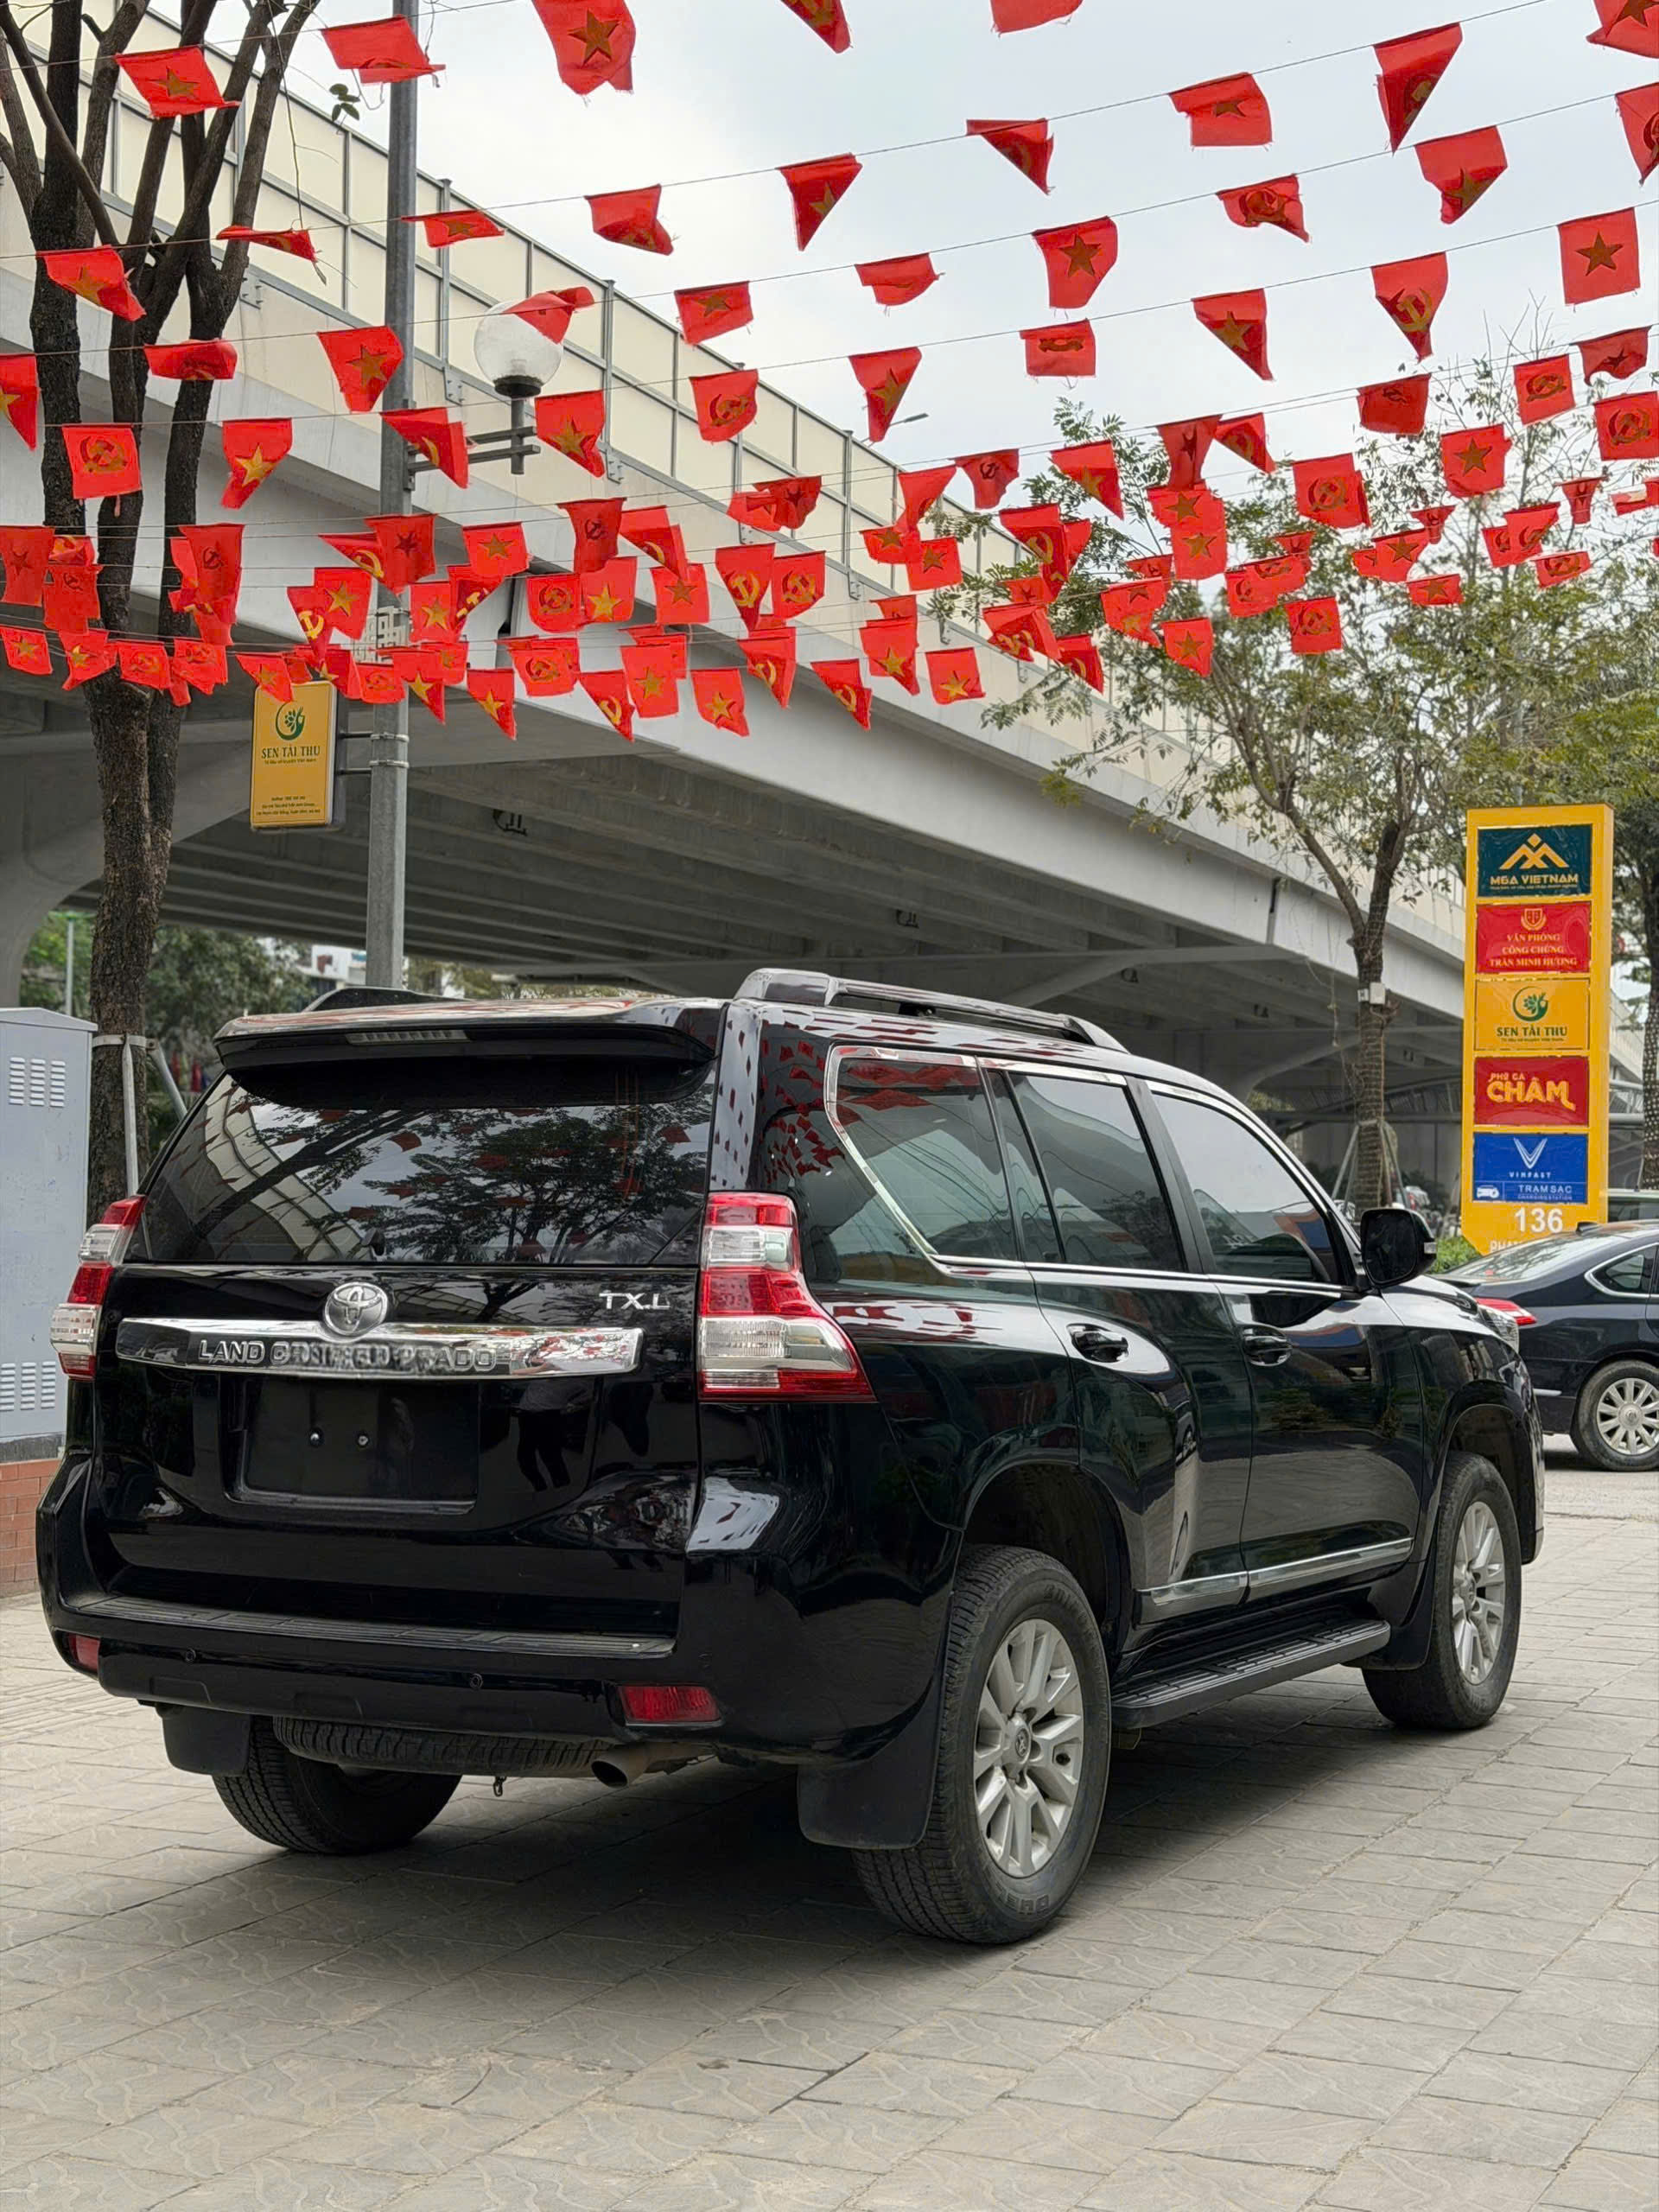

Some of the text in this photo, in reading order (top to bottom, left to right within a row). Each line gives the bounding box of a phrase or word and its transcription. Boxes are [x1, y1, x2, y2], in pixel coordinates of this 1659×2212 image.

[261, 747, 279, 759] SEN
[301, 746, 321, 757] THU
[1521, 874, 1579, 885] VIETNAM
[1497, 1027, 1518, 1037] SEN
[1544, 1026, 1568, 1037] THU
[1509, 1171, 1552, 1179] VINFAST
[1515, 1206, 1563, 1233] 136
[198, 1339, 265, 1364] LAND
